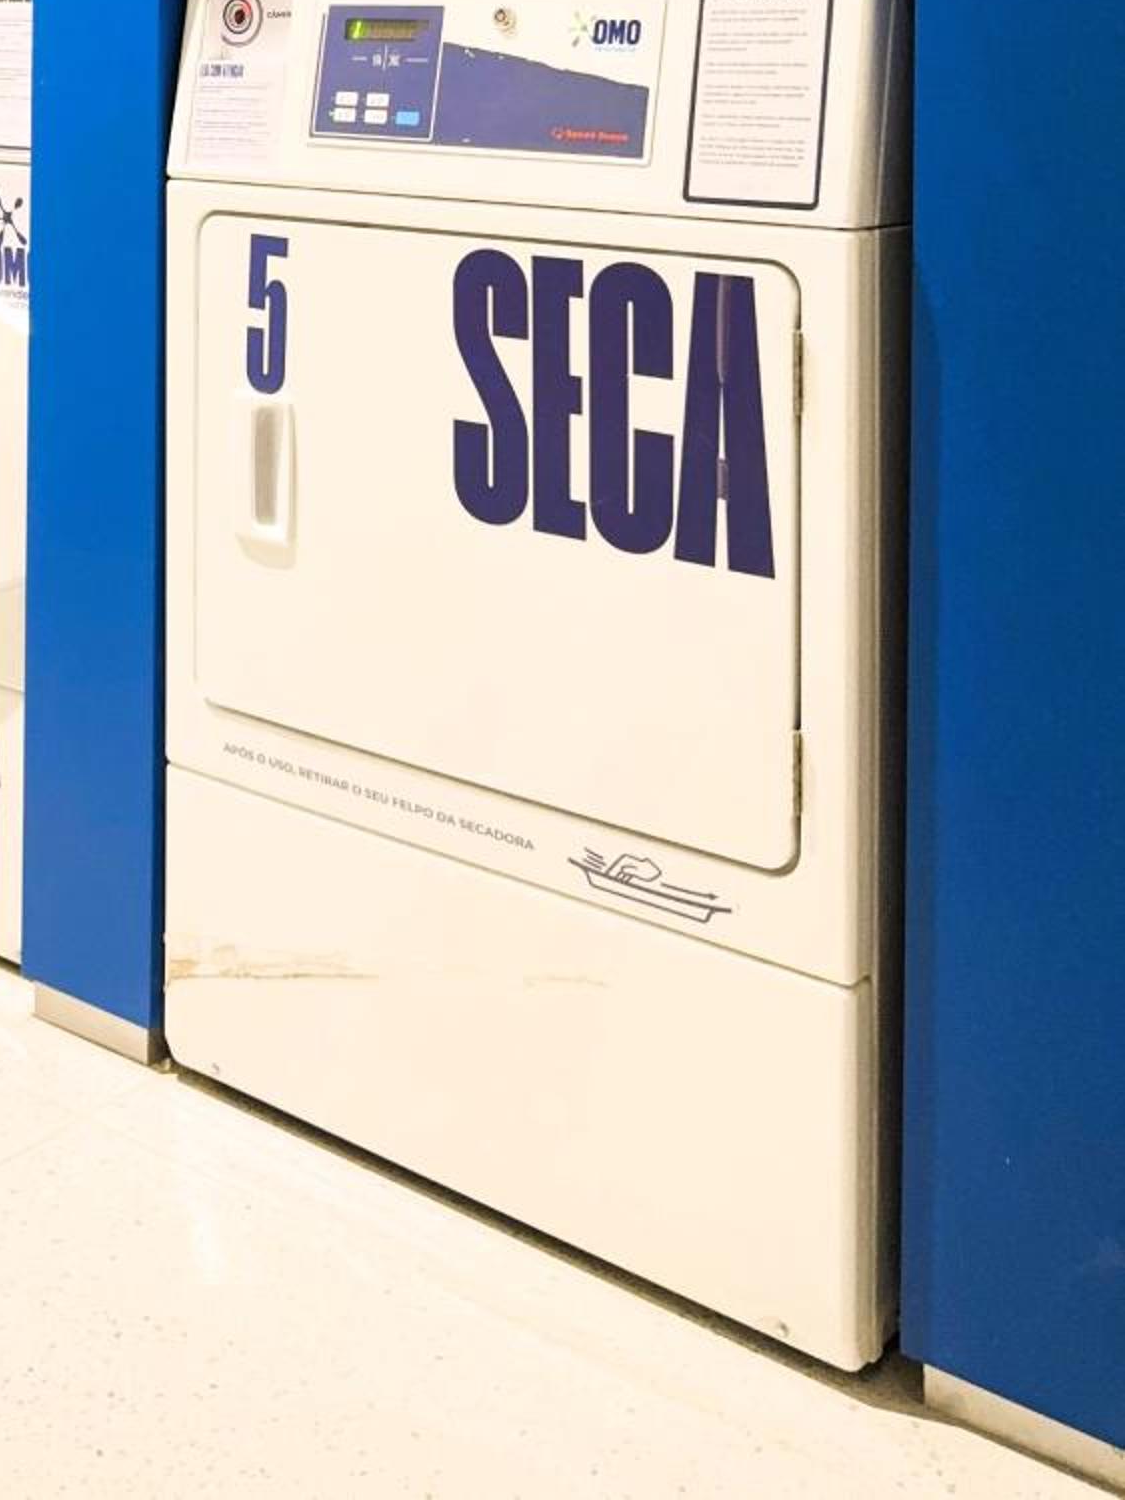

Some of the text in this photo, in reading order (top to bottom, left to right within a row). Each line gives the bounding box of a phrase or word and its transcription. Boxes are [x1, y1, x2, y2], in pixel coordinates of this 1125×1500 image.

[592, 18, 642, 45] OMO
[246, 233, 289, 395] 5
[453, 249, 775, 580] SECA
[223, 742, 254, 761] APÓS
[256, 753, 266, 764] O
[298, 766, 349, 790] RETIRAR
[352, 784, 362, 795] O
[364, 789, 389, 805] SEU
[392, 797, 434, 819] FELPO
[436, 811, 456, 827] DA
[459, 818, 536, 850] SECADORA
